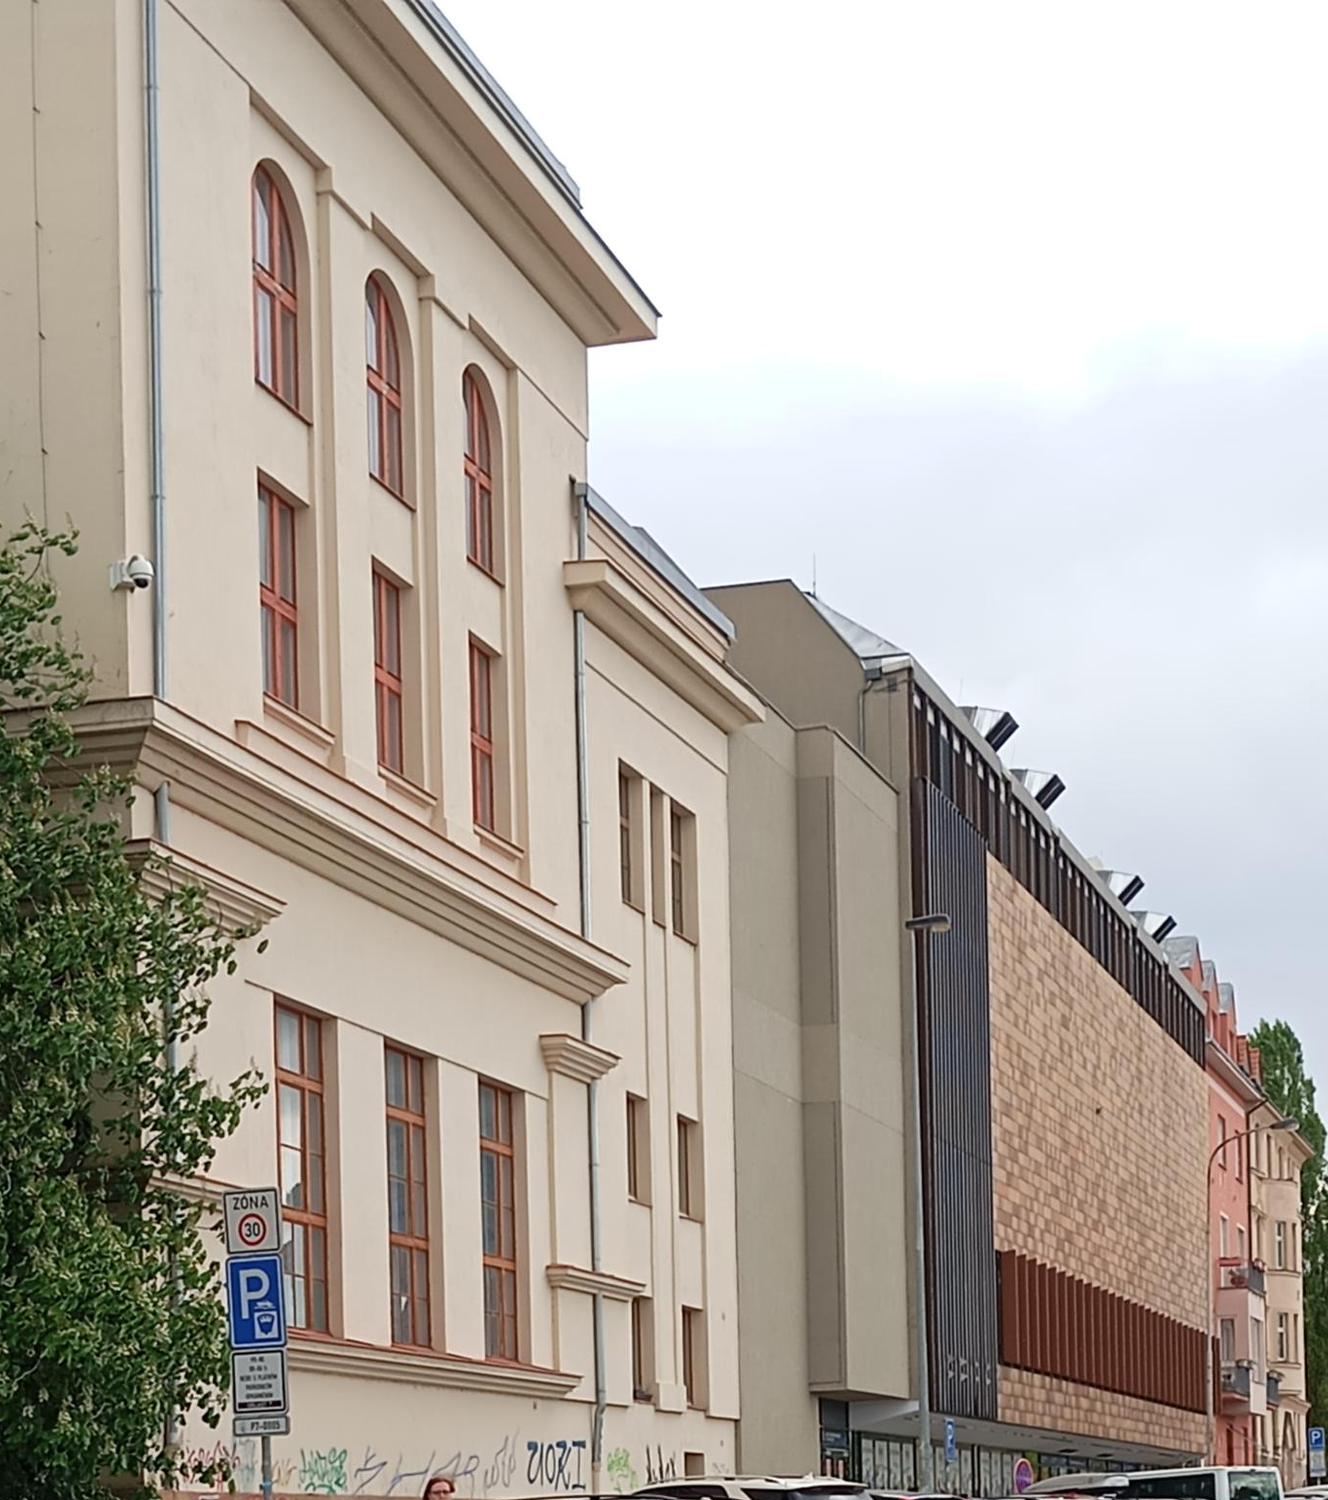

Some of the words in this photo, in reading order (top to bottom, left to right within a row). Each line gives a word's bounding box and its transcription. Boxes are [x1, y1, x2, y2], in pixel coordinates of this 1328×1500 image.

[232, 1193, 270, 1211] ZÓNA
[244, 1221, 261, 1238] 30
[238, 1268, 271, 1320] P
[1311, 1430, 1321, 1444] P
